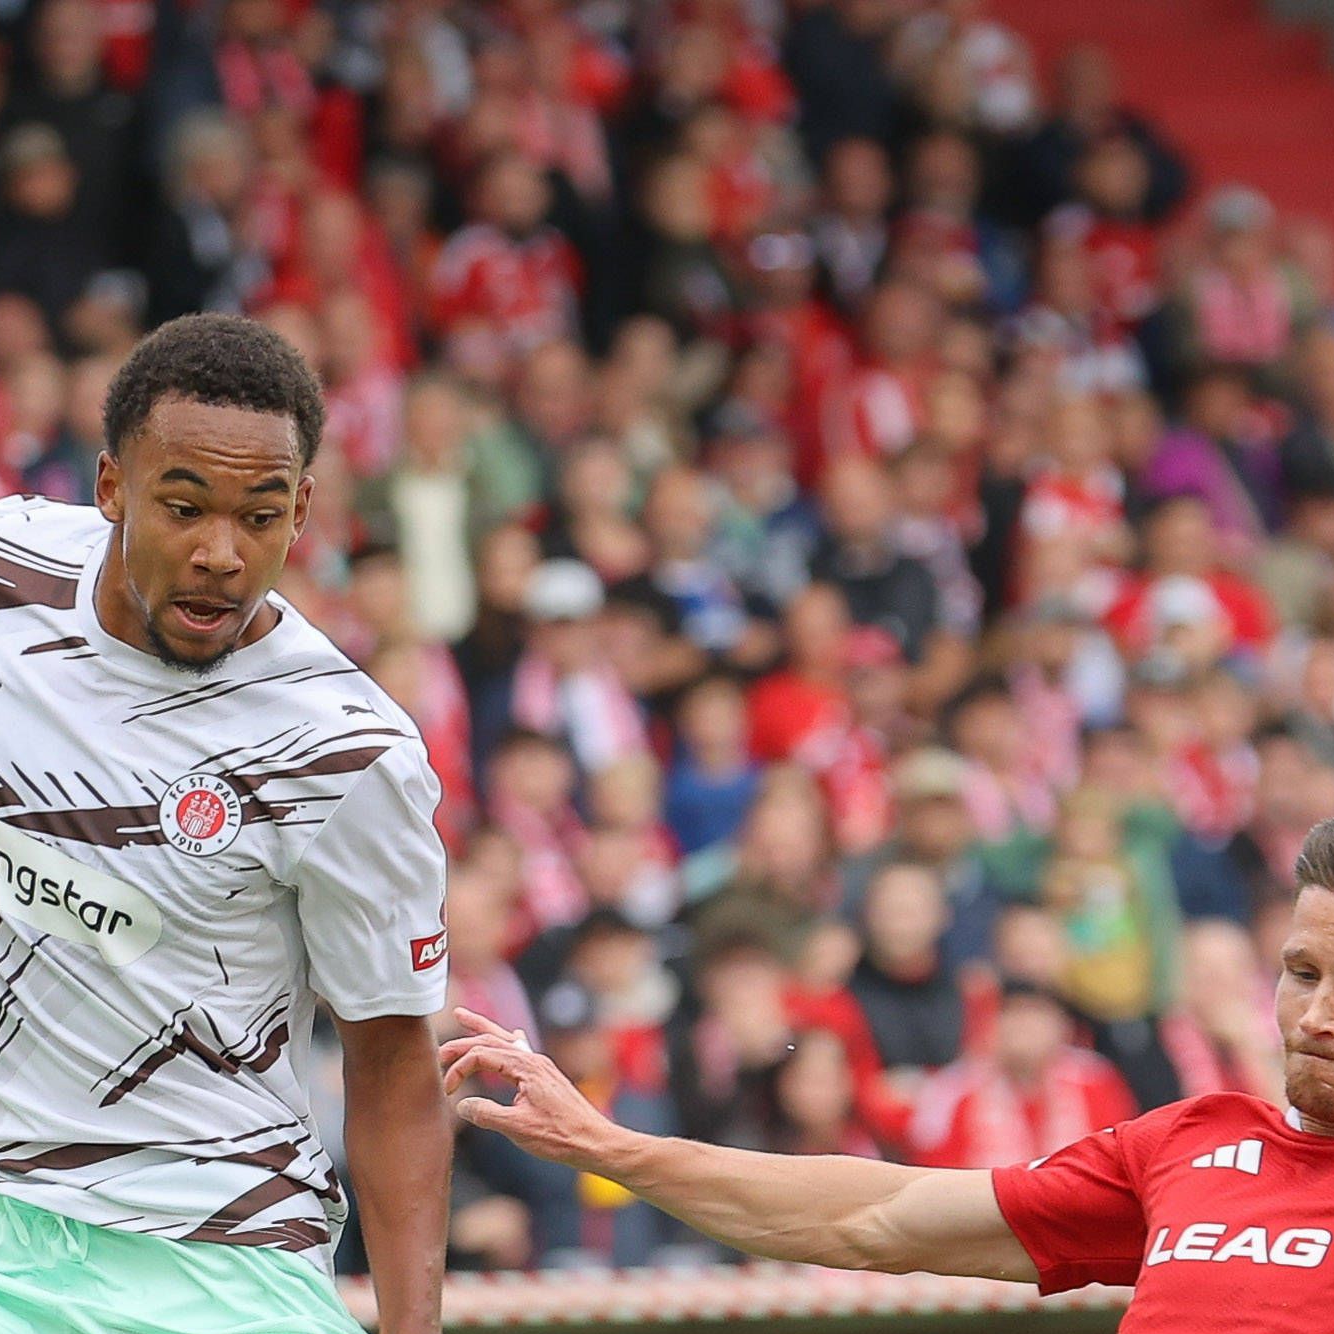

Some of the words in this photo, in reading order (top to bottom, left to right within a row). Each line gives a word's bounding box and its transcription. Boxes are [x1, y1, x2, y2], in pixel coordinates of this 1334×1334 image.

[169, 784, 185, 800] FC
[214, 782, 238, 827] PAULI
[171, 832, 202, 853] 1910
